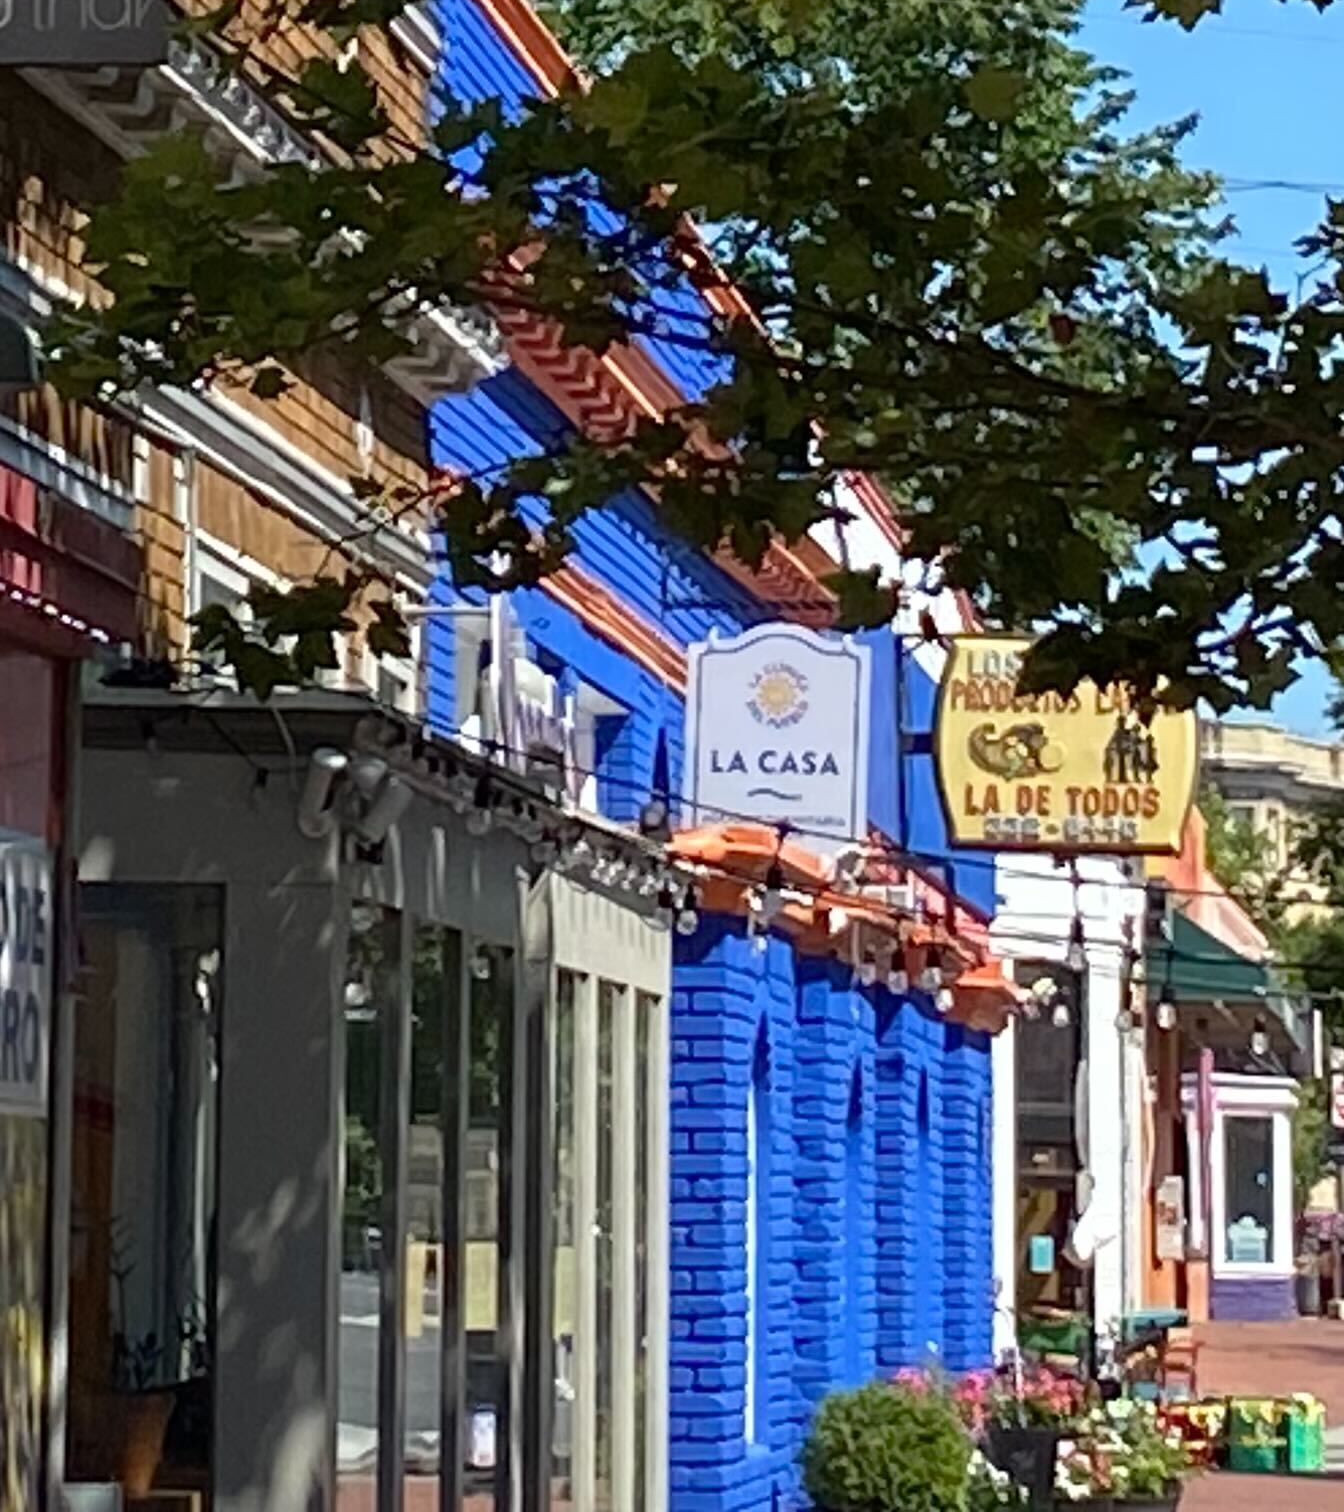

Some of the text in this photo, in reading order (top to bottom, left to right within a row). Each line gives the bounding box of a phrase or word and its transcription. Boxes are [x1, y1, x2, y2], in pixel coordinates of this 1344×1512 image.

[710, 749, 840, 776] LA CASA
[964, 783, 1161, 819] LA DE TODOS
